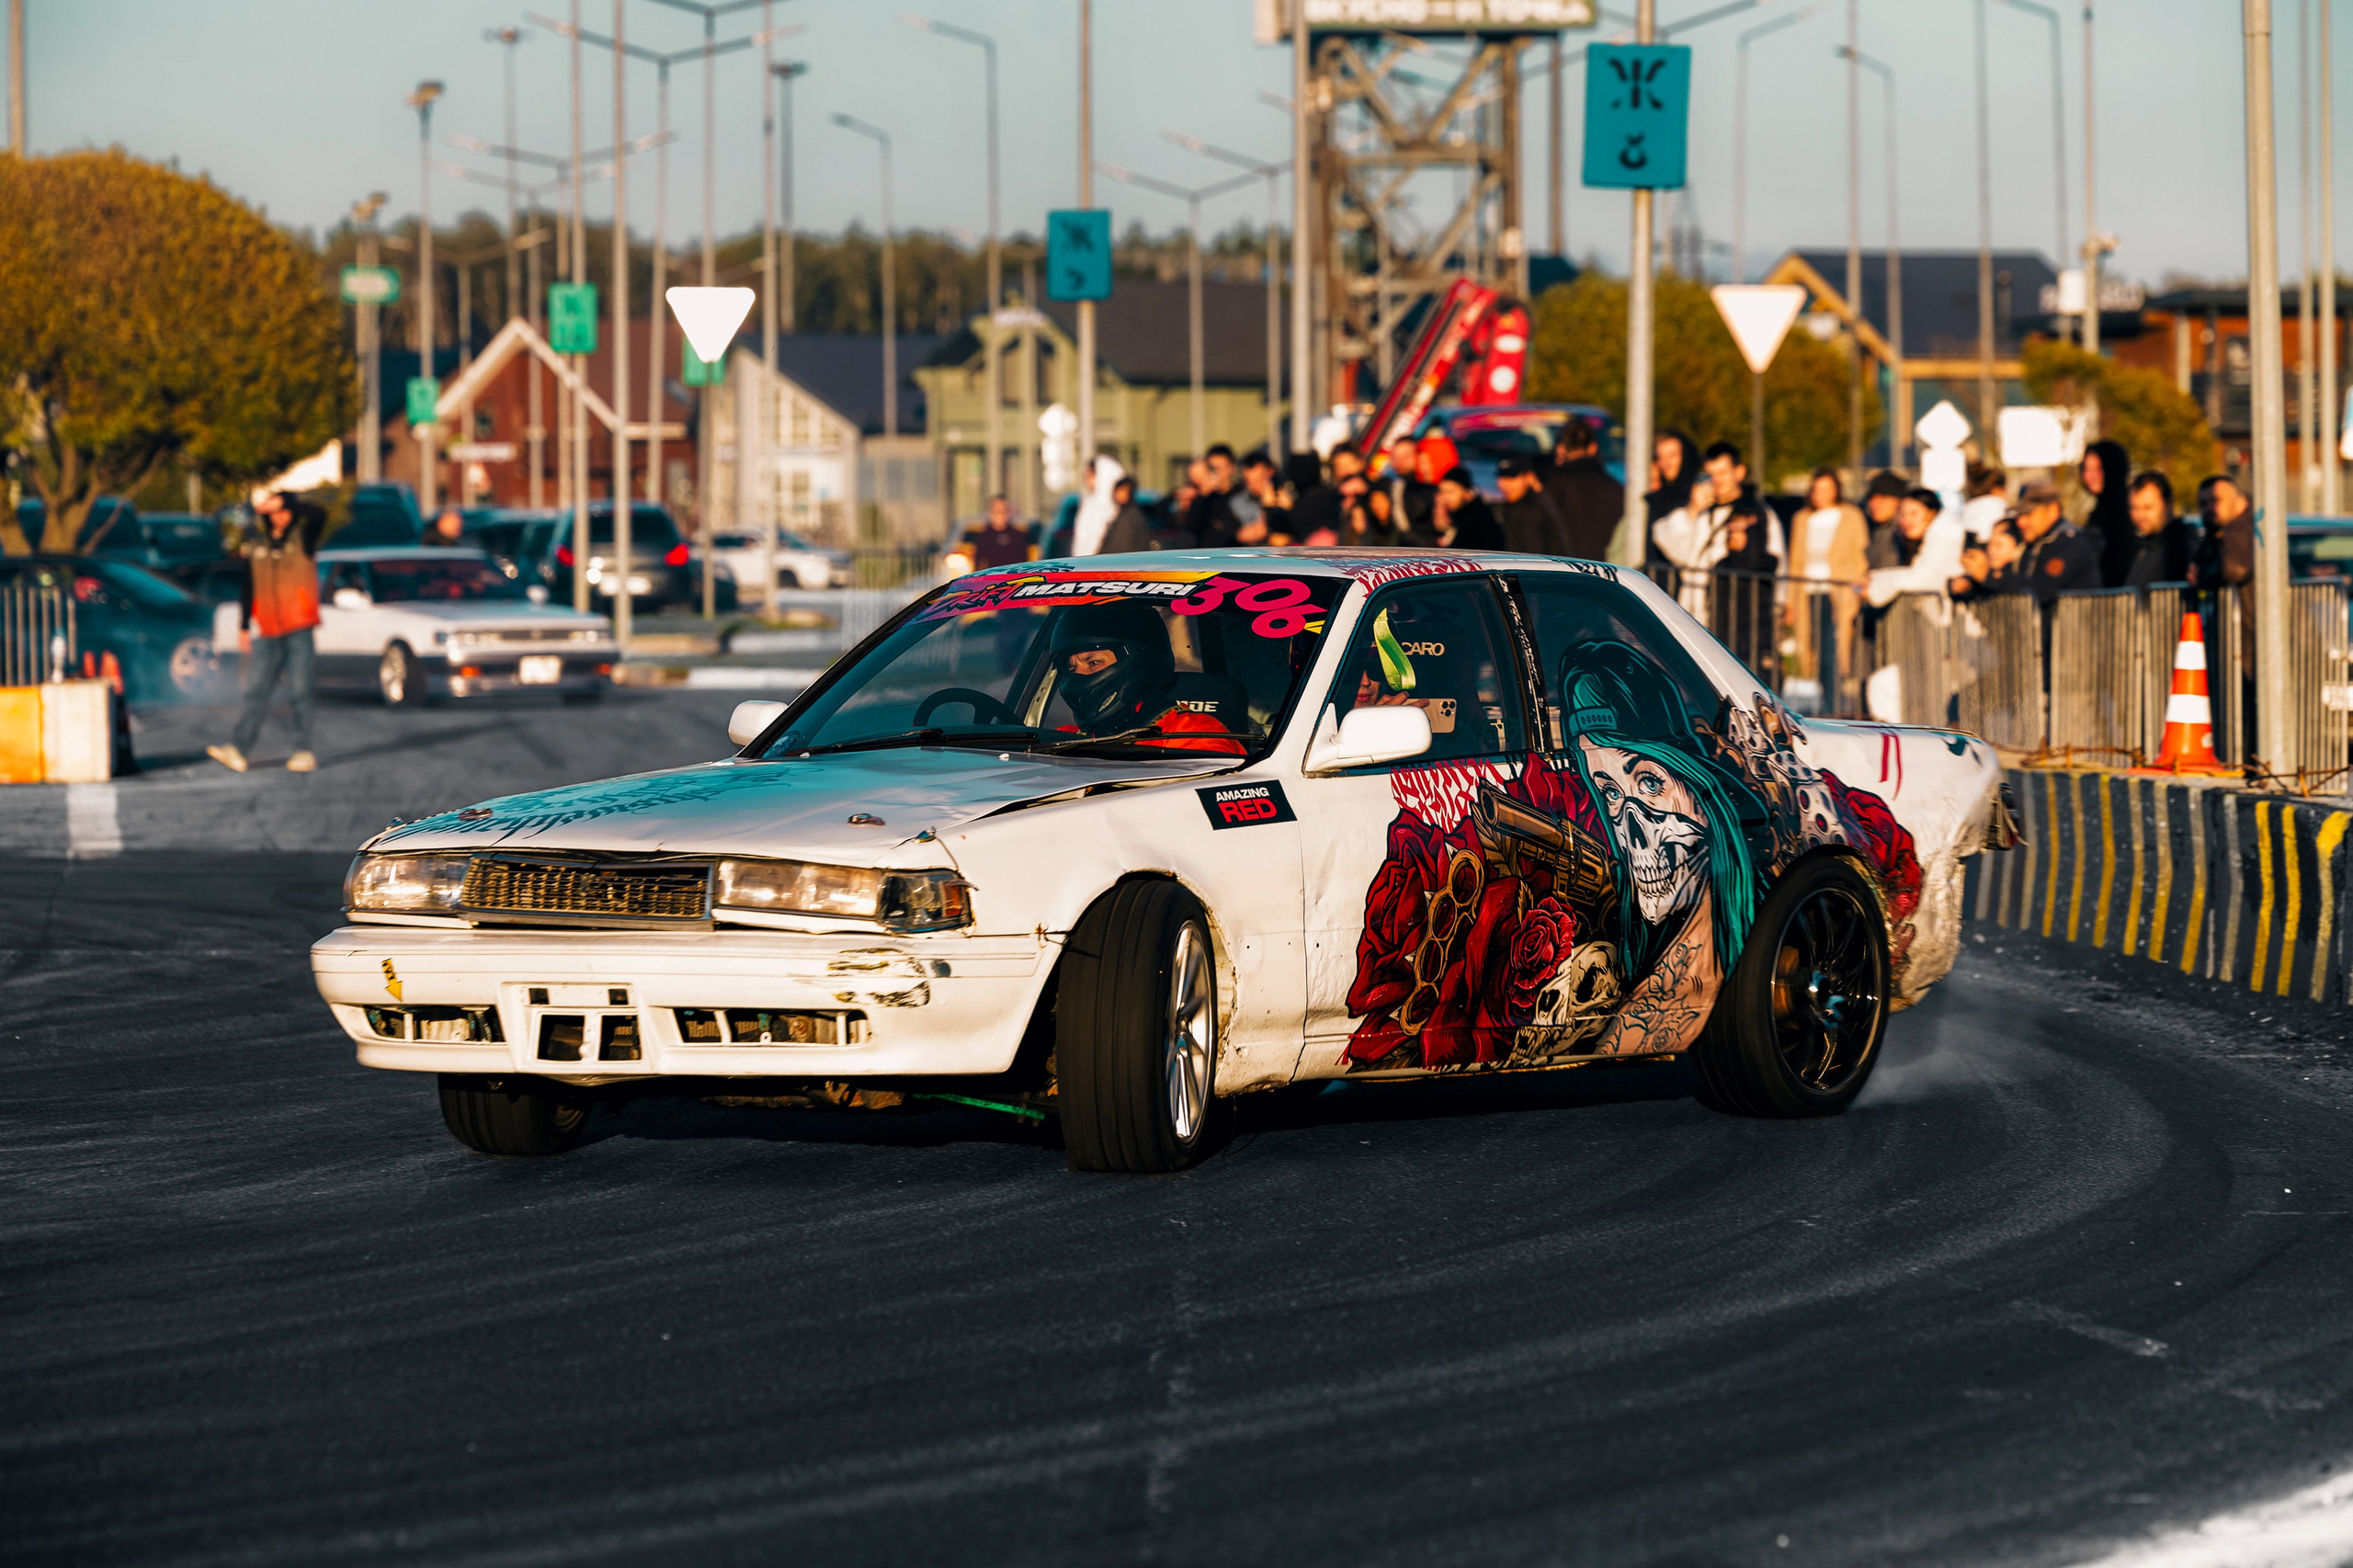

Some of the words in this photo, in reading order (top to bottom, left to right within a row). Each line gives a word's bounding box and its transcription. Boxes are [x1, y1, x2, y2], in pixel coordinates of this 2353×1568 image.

[1013, 580, 1199, 597] MATSURI
[1170, 575, 1329, 639] 306
[1215, 787, 1270, 802] AMAZING
[1218, 798, 1278, 823] RED
